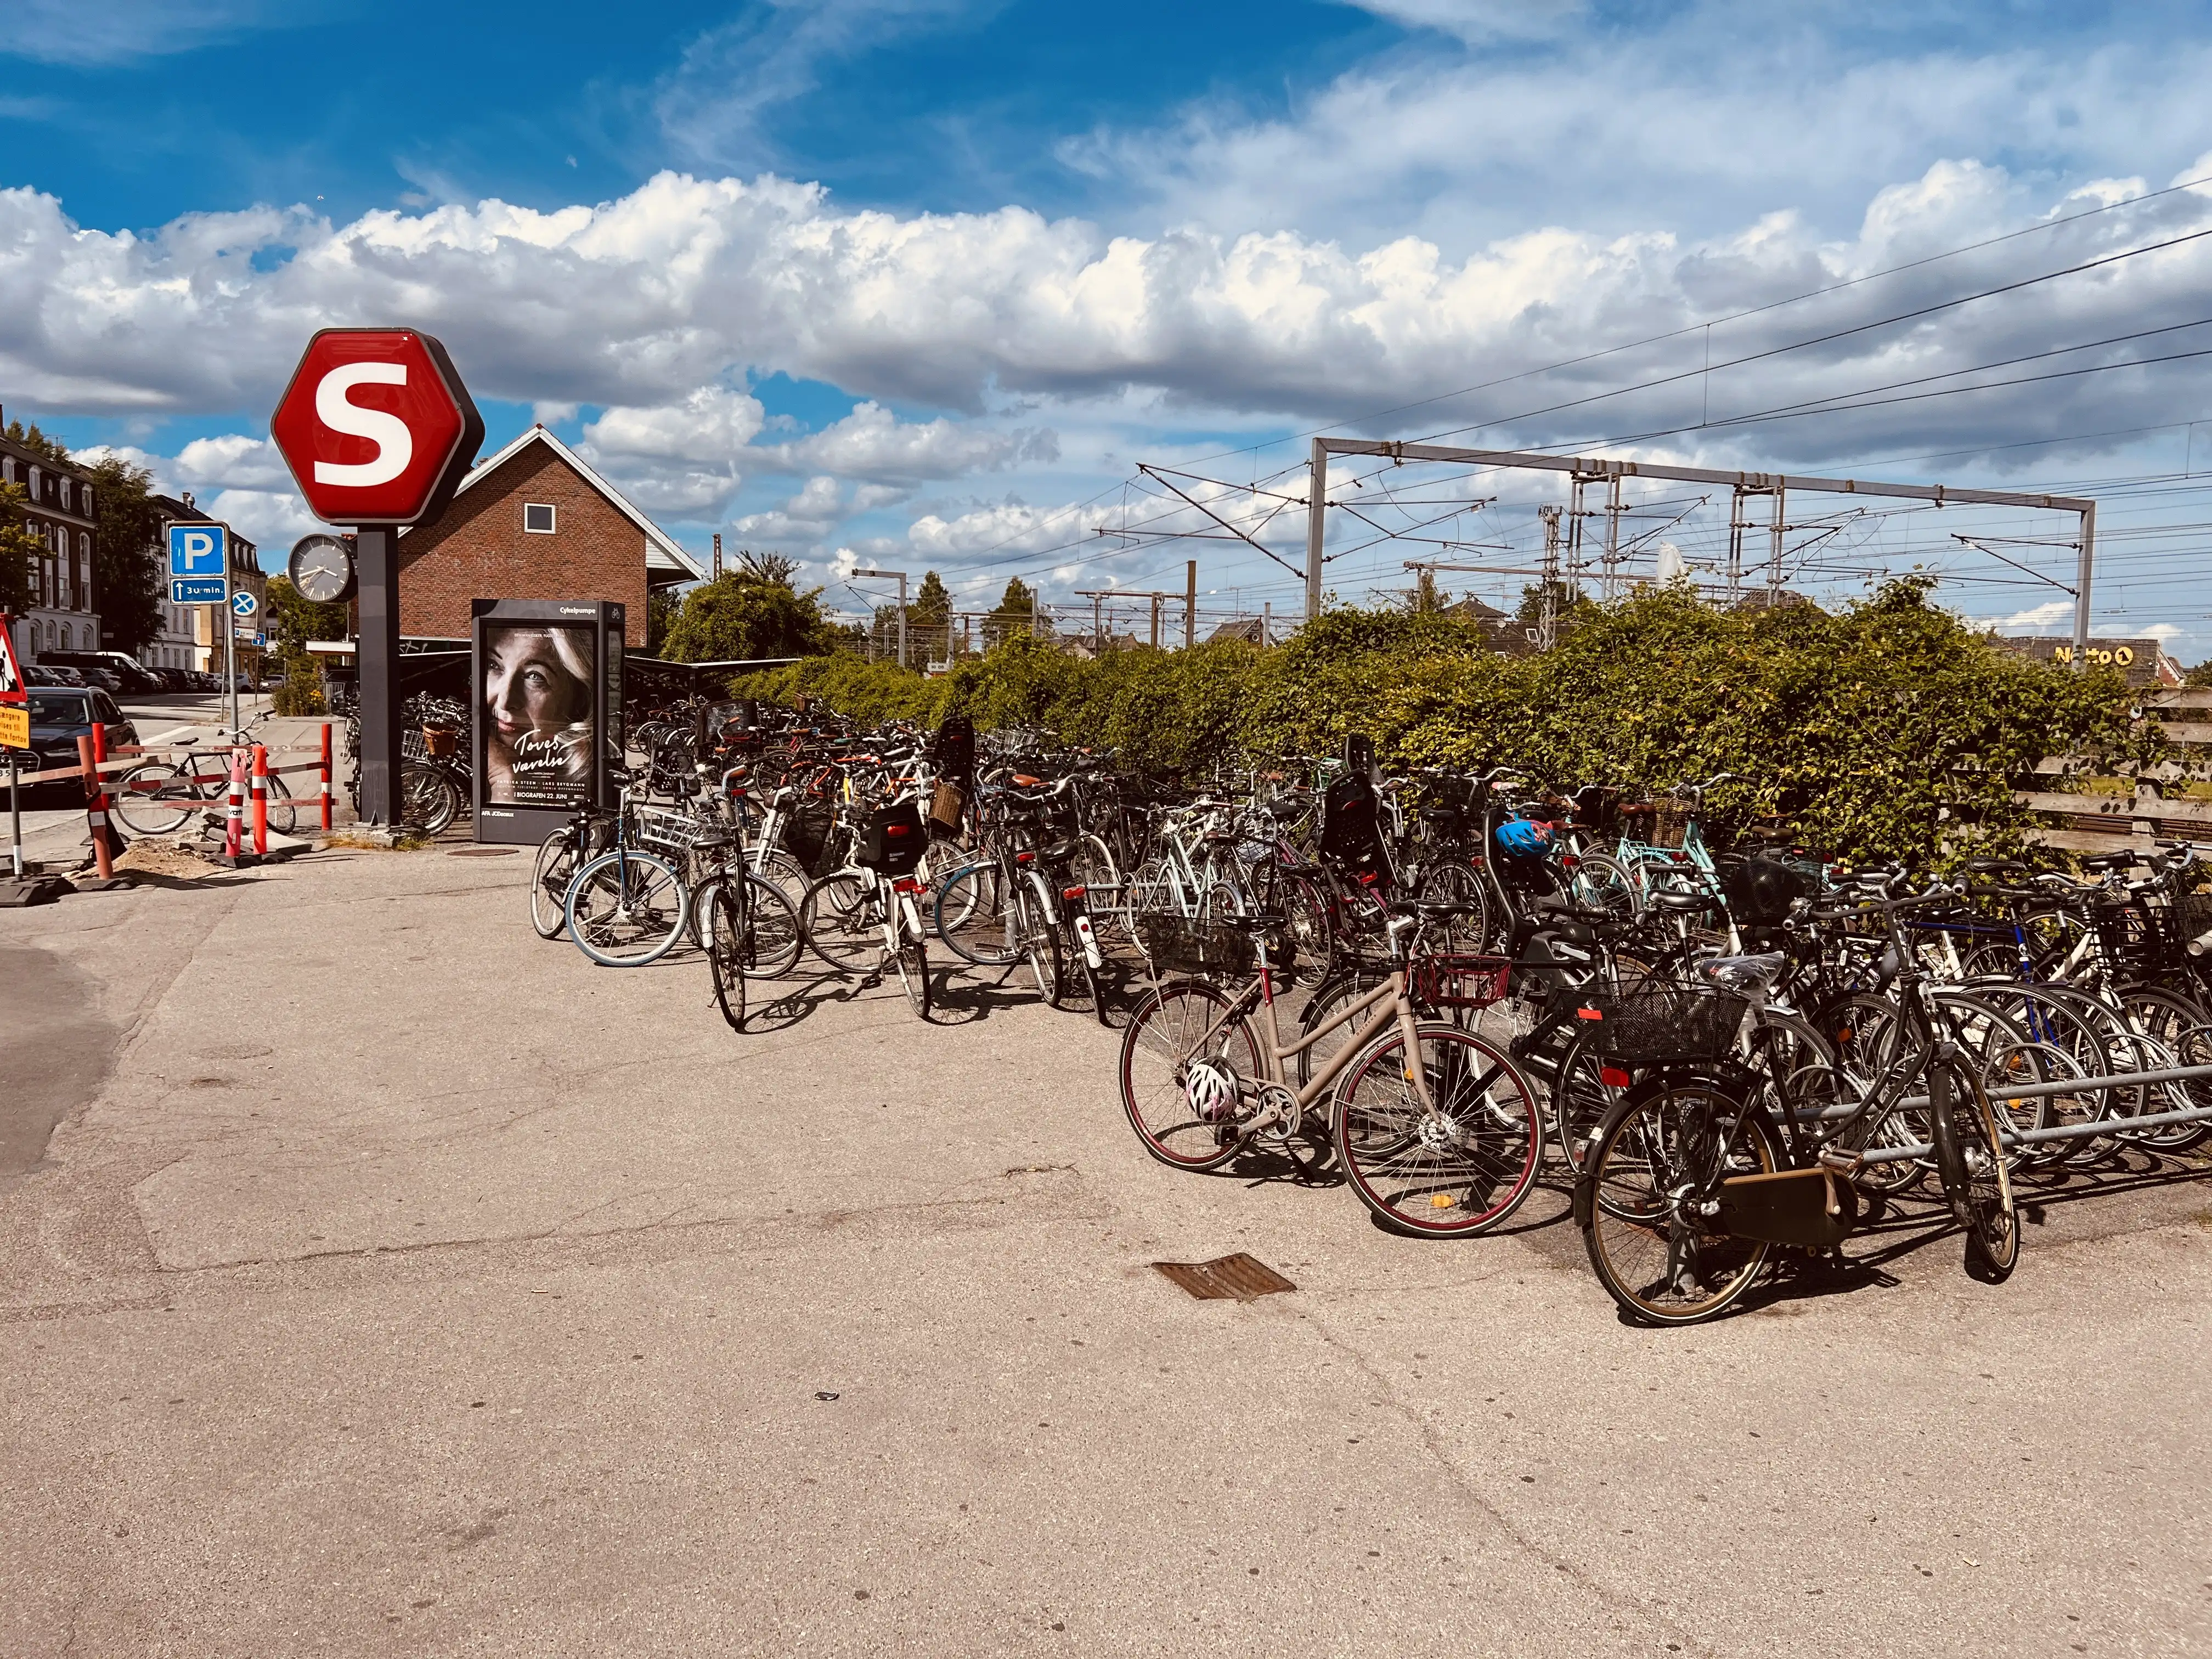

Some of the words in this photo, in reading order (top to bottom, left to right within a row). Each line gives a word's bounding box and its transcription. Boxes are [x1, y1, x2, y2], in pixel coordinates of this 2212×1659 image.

[314, 362, 413, 487] S
[184, 533, 213, 569] P
[515, 729, 558, 755] Toves
